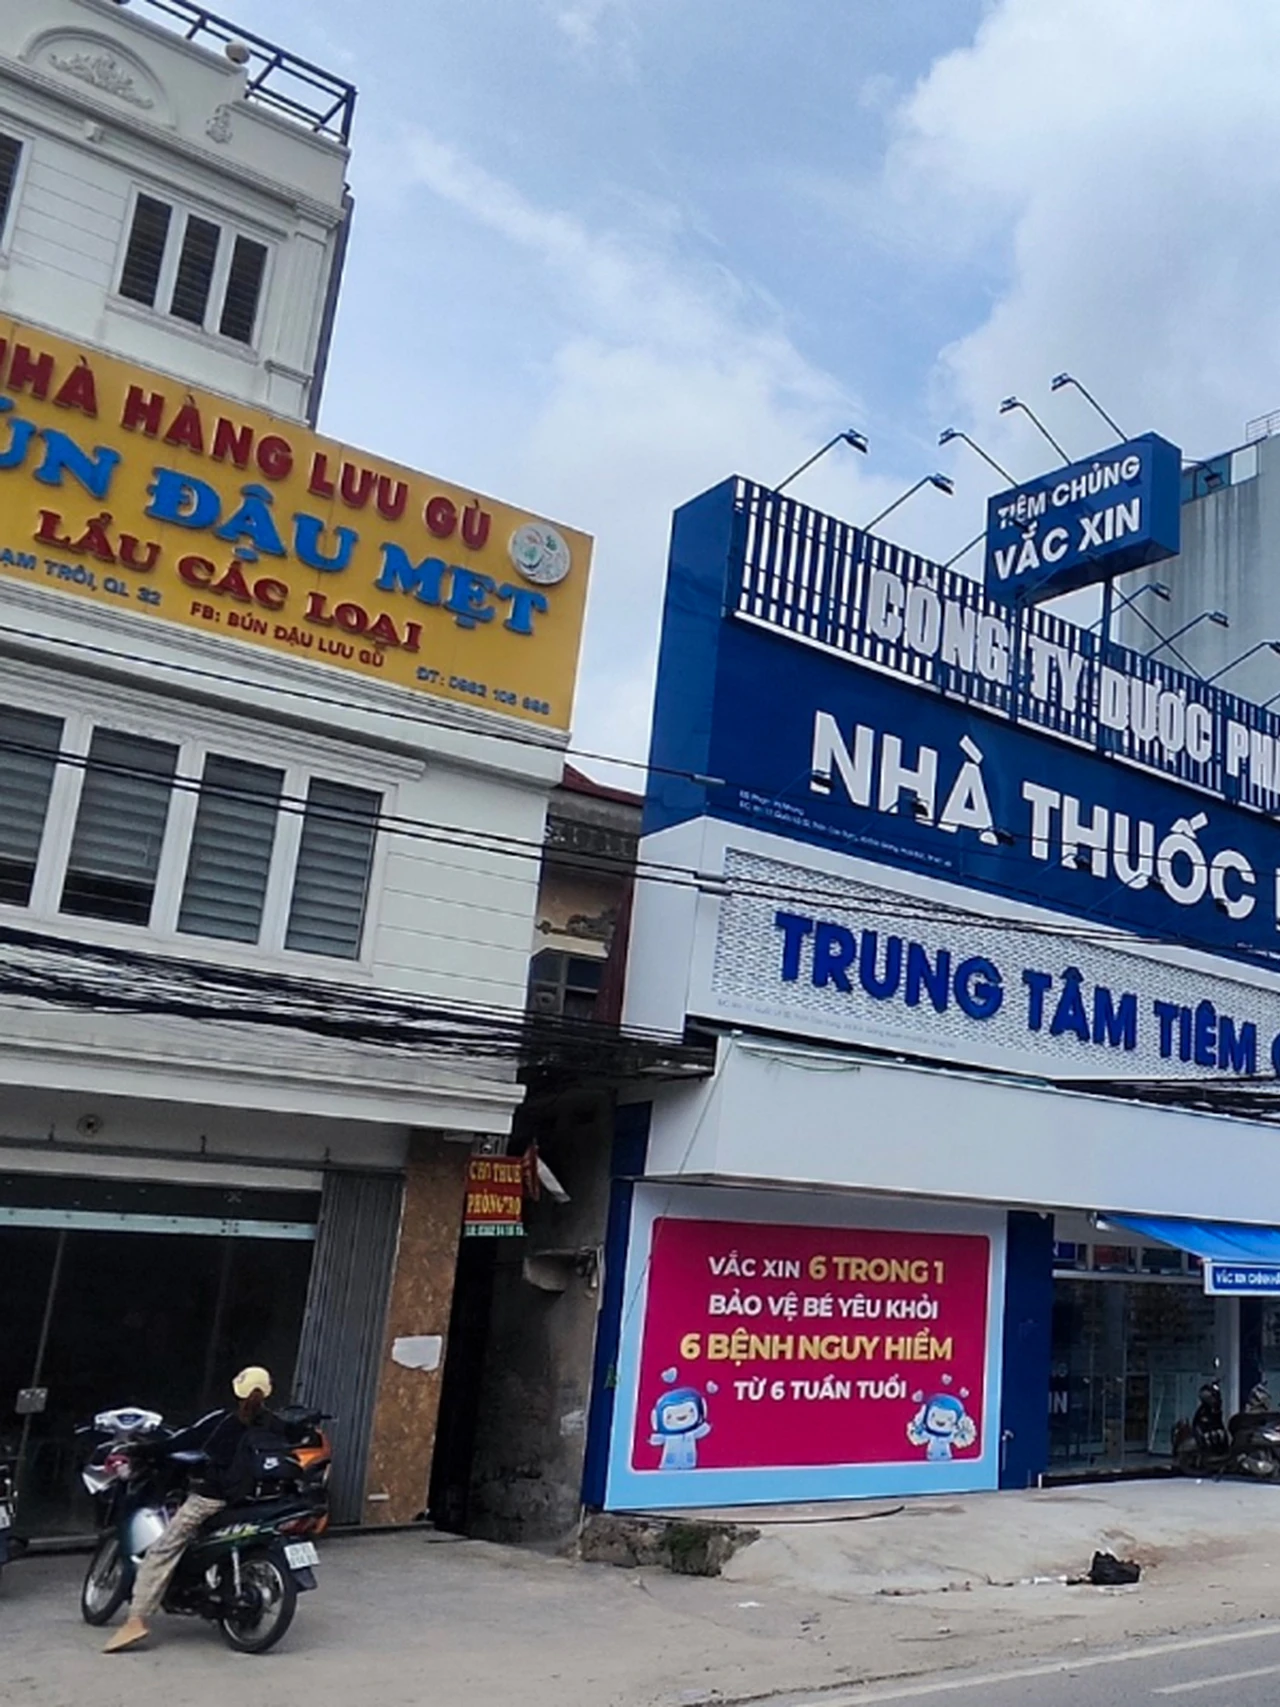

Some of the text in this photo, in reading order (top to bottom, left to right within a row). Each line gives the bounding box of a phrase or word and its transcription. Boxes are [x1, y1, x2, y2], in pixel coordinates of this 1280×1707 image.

[0, 337, 492, 551] HÀ HÀNG LƯU GÙ
[997, 455, 1141, 530] TIÊM CHỦNG
[145, 466, 359, 573] ĐẬU
[374, 541, 549, 636] MẸT
[993, 497, 1141, 581] VẮC XIN
[177, 554, 290, 612] CÁC
[303, 591, 424, 654] LOẠI
[190, 601, 221, 623] FB:
[226, 612, 269, 636] BÚN
[273, 625, 314, 648] ĐẬU
[317, 637, 355, 660] LƯU
[866, 568, 1010, 686] CÔNG
[1028, 633, 1086, 713] TY
[1098, 664, 1213, 765] DƯỢC
[809, 708, 1001, 848] NHÀ
[1022, 781, 1257, 920] THUỐC
[774, 910, 1004, 1020] TRUNG
[1021, 966, 1139, 1052] TÂM
[1152, 999, 1258, 1075] TIÊM
[708, 1249, 945, 1285] VẮC XIN 6 TRONG 1
[708, 1288, 939, 1321] BẢO VỆ BÉ YÊU KHỎI
[680, 1326, 953, 1367] 6 BỆNH NGUY HIỂM
[733, 1373, 907, 1401] TỪ 6 TUẦN TUỔI
